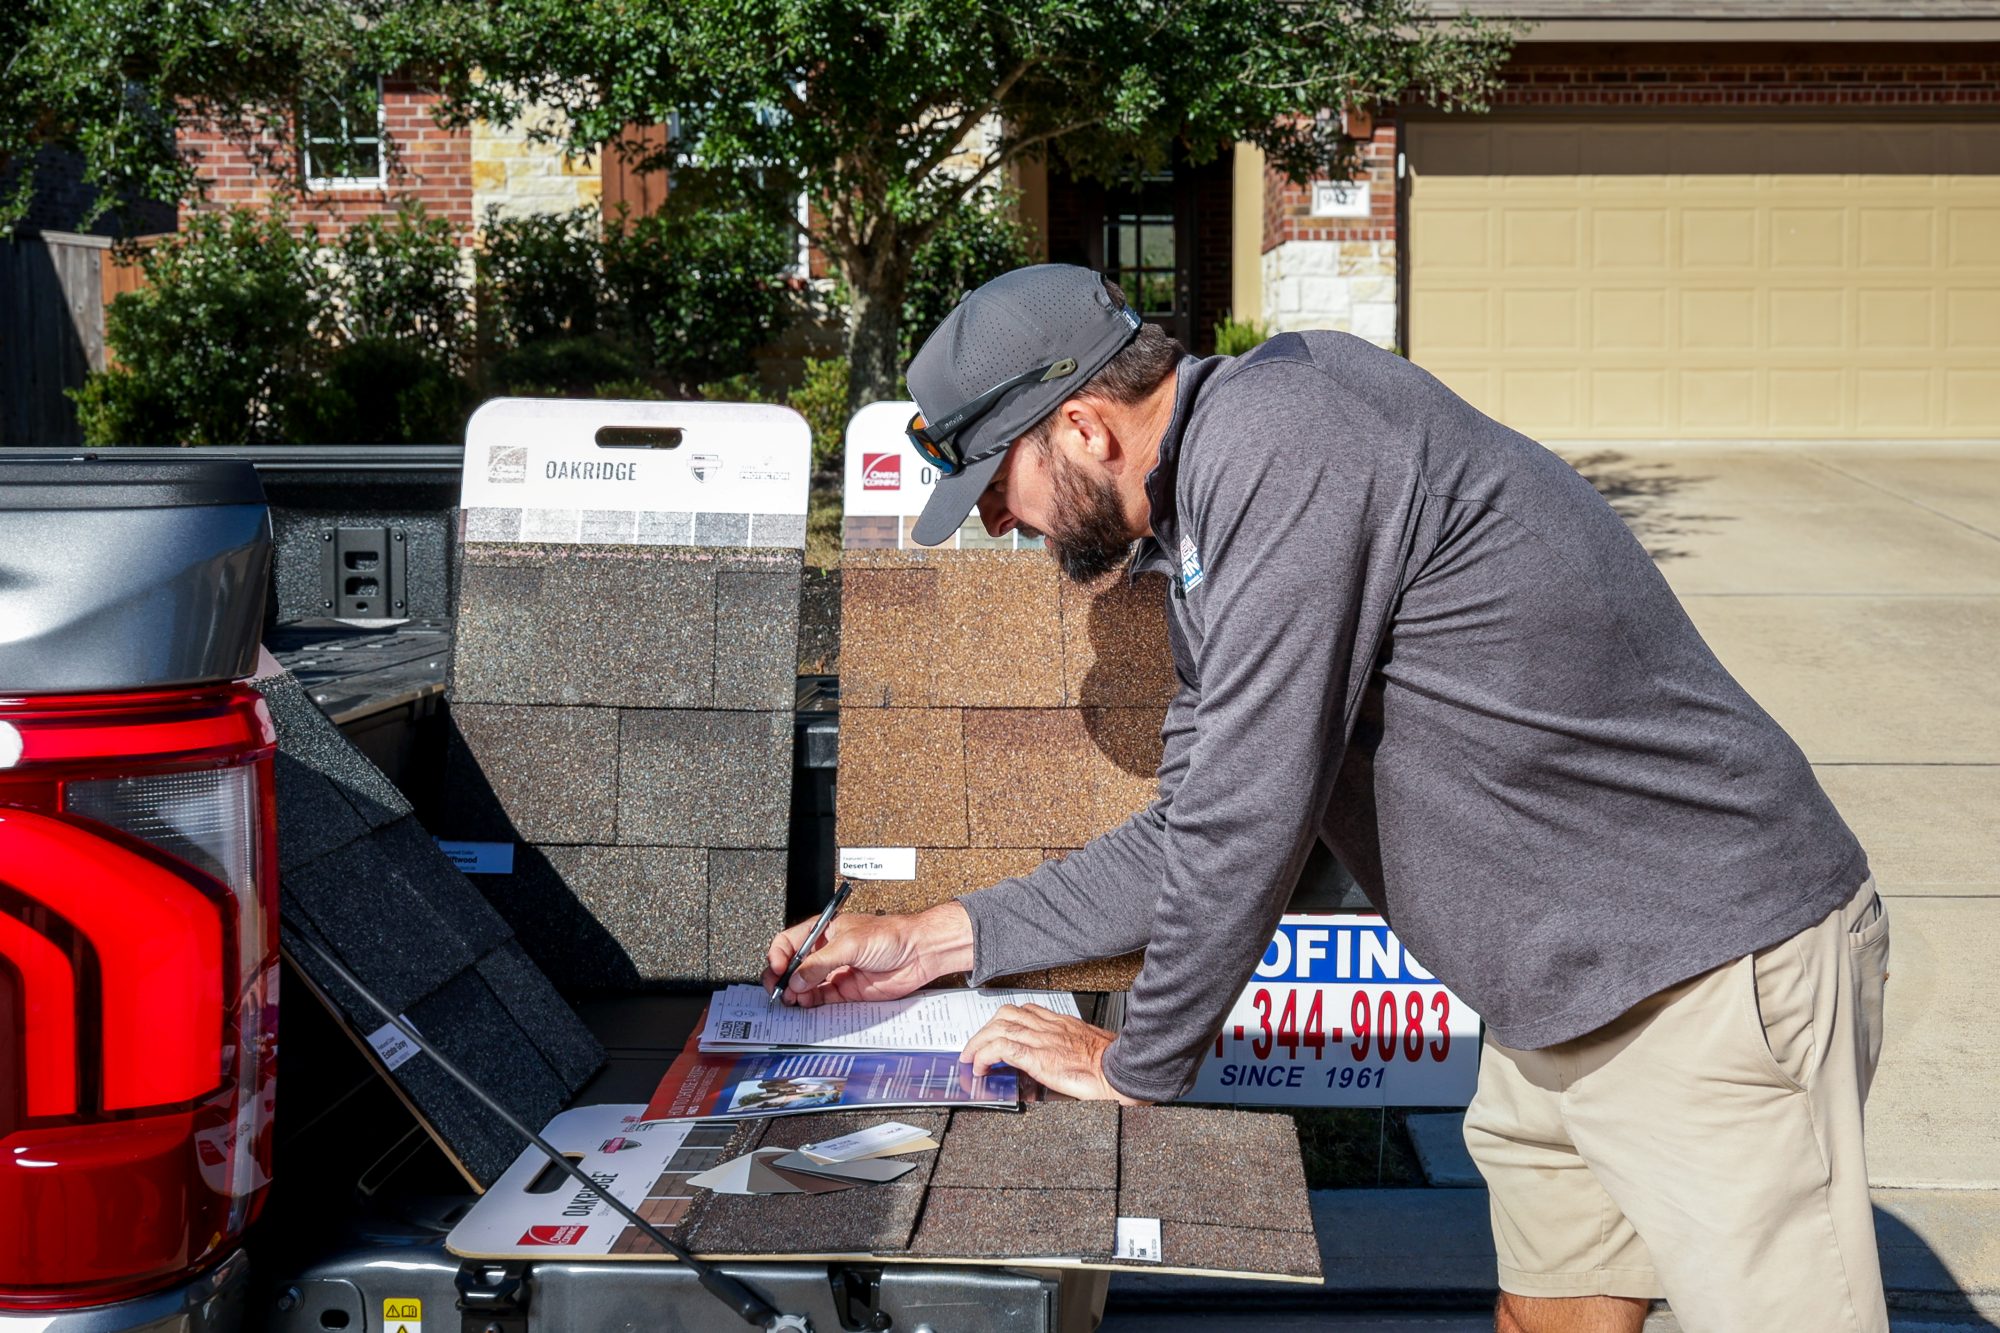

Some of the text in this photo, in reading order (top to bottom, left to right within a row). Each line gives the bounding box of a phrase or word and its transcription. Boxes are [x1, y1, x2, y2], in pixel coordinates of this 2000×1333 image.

[546, 461, 637, 481] OAKRIDGE
[865, 478, 900, 487] CORNING
[1220, 1064, 1386, 1089] SINCE 1961
